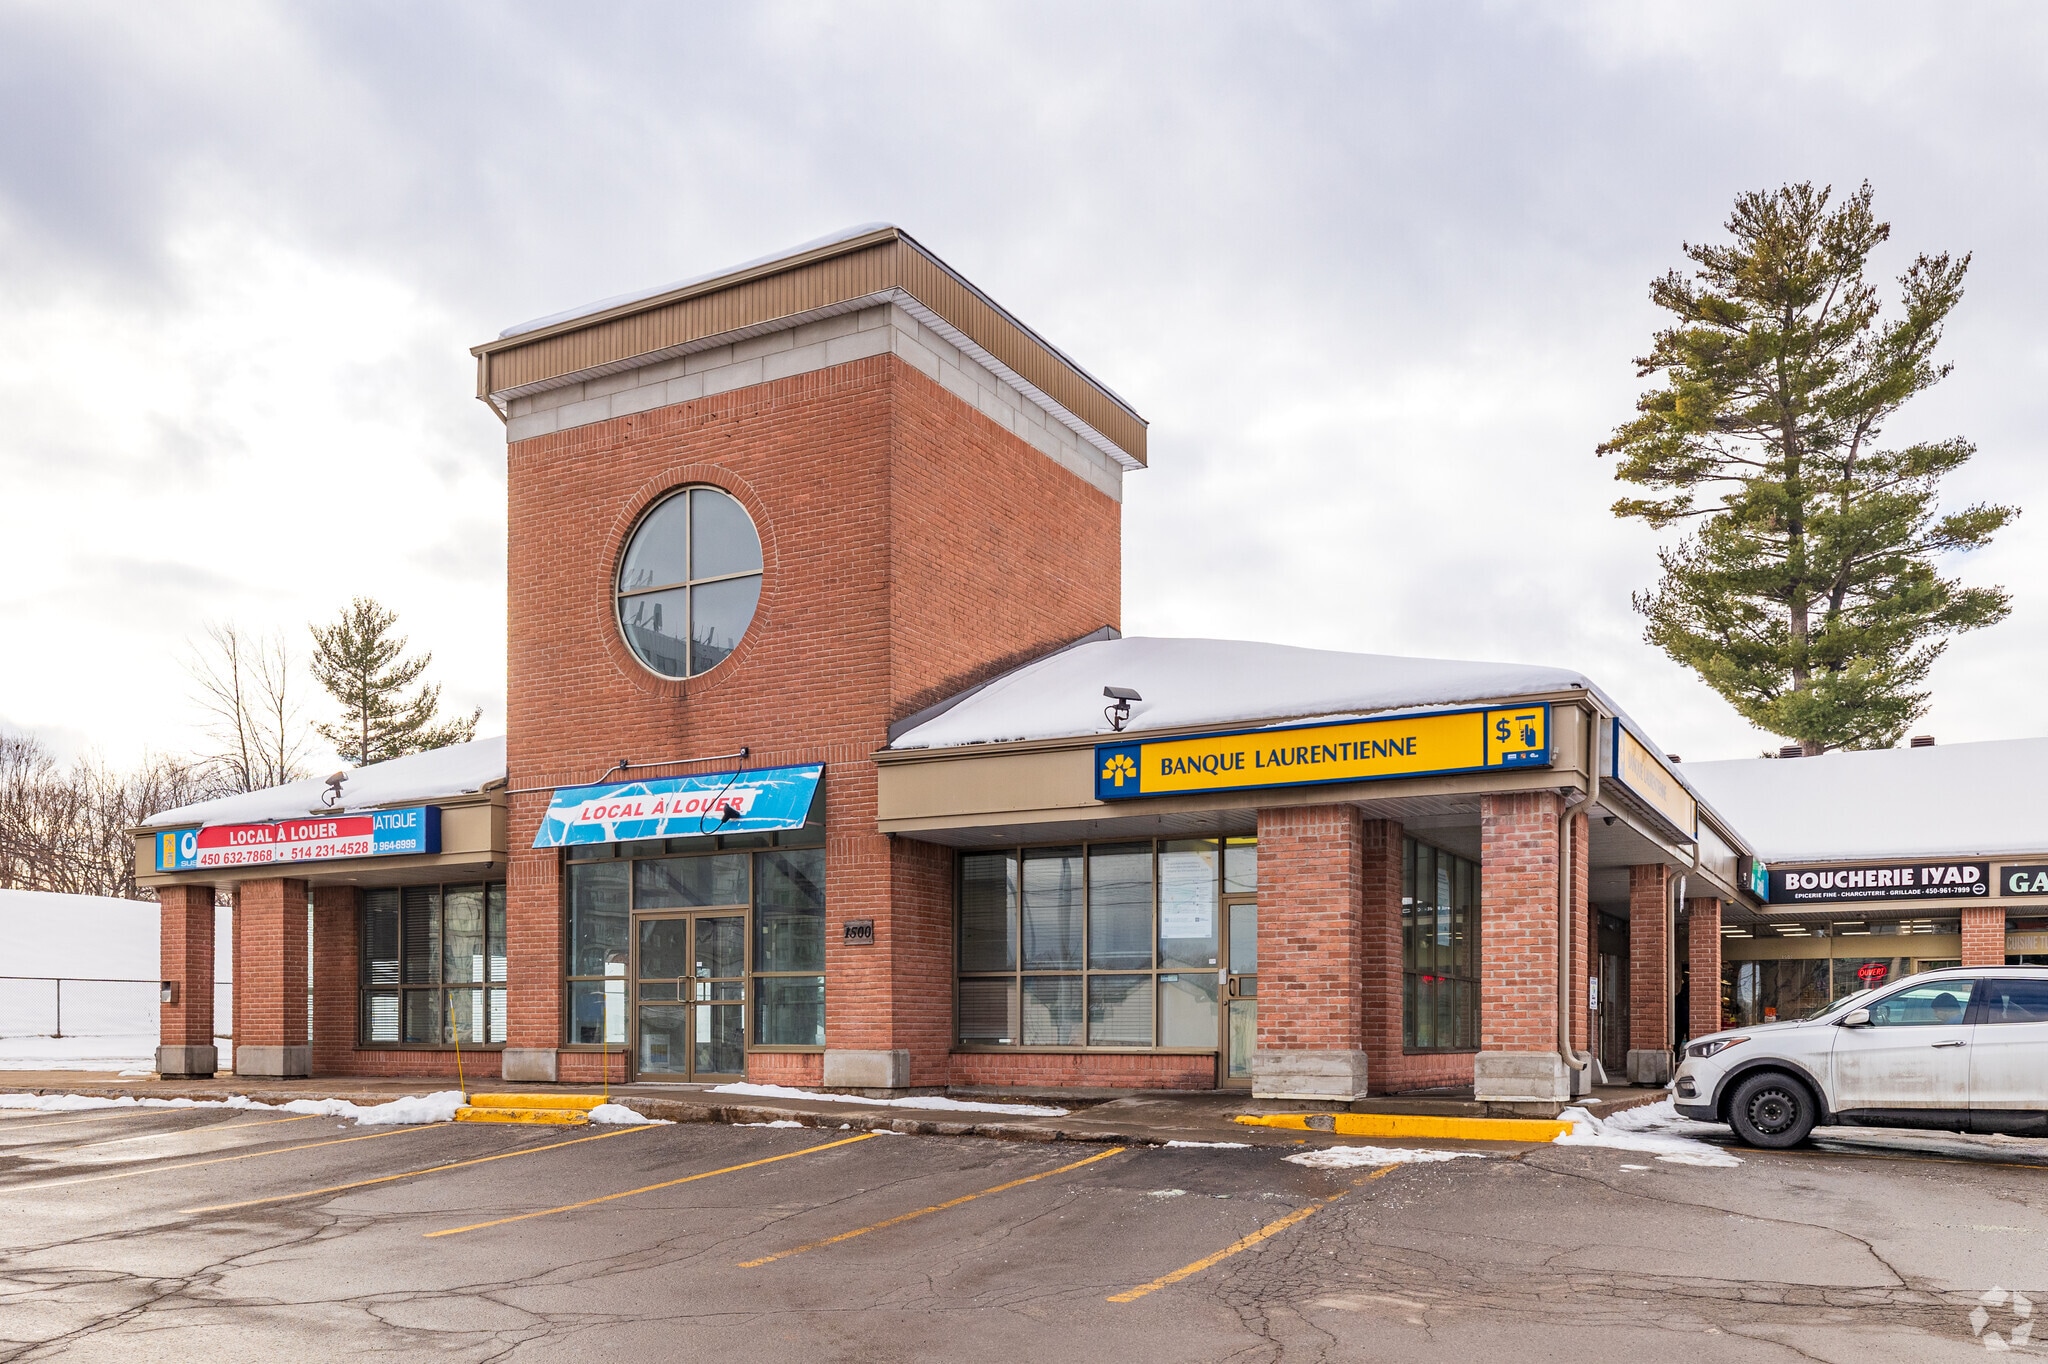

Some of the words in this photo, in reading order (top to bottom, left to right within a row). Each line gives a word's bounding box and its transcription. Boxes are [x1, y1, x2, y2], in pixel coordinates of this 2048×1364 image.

[1161, 751, 1245, 776] BANQUE
[1256, 736, 1417, 769] LAURENTIENNE
[581, 802, 644, 821] LOCAL
[652, 797, 664, 815] À
[672, 796, 744, 815] LOUER
[373, 812, 417, 831] ATIQUE
[229, 829, 272, 845] LOCAL
[277, 825, 286, 841] À
[291, 822, 338, 841] LOUER
[200, 853, 220, 865] 450
[223, 850, 273, 864] 632-7868
[291, 847, 312, 860] 514
[315, 841, 369, 857] 231-4528
[379, 839, 416, 852] 964-6999
[1785, 868, 1914, 890] BOUCHERIE
[1921, 866, 1980, 886] IYAD
[1840, 889, 1886, 897] CHARCUTERIE
[1889, 888, 1921, 896] GRILLADE
[844, 925, 871, 939] 1500
[2006, 935, 2038, 950] CUISINE
[1859, 967, 1884, 977] OUVERT
